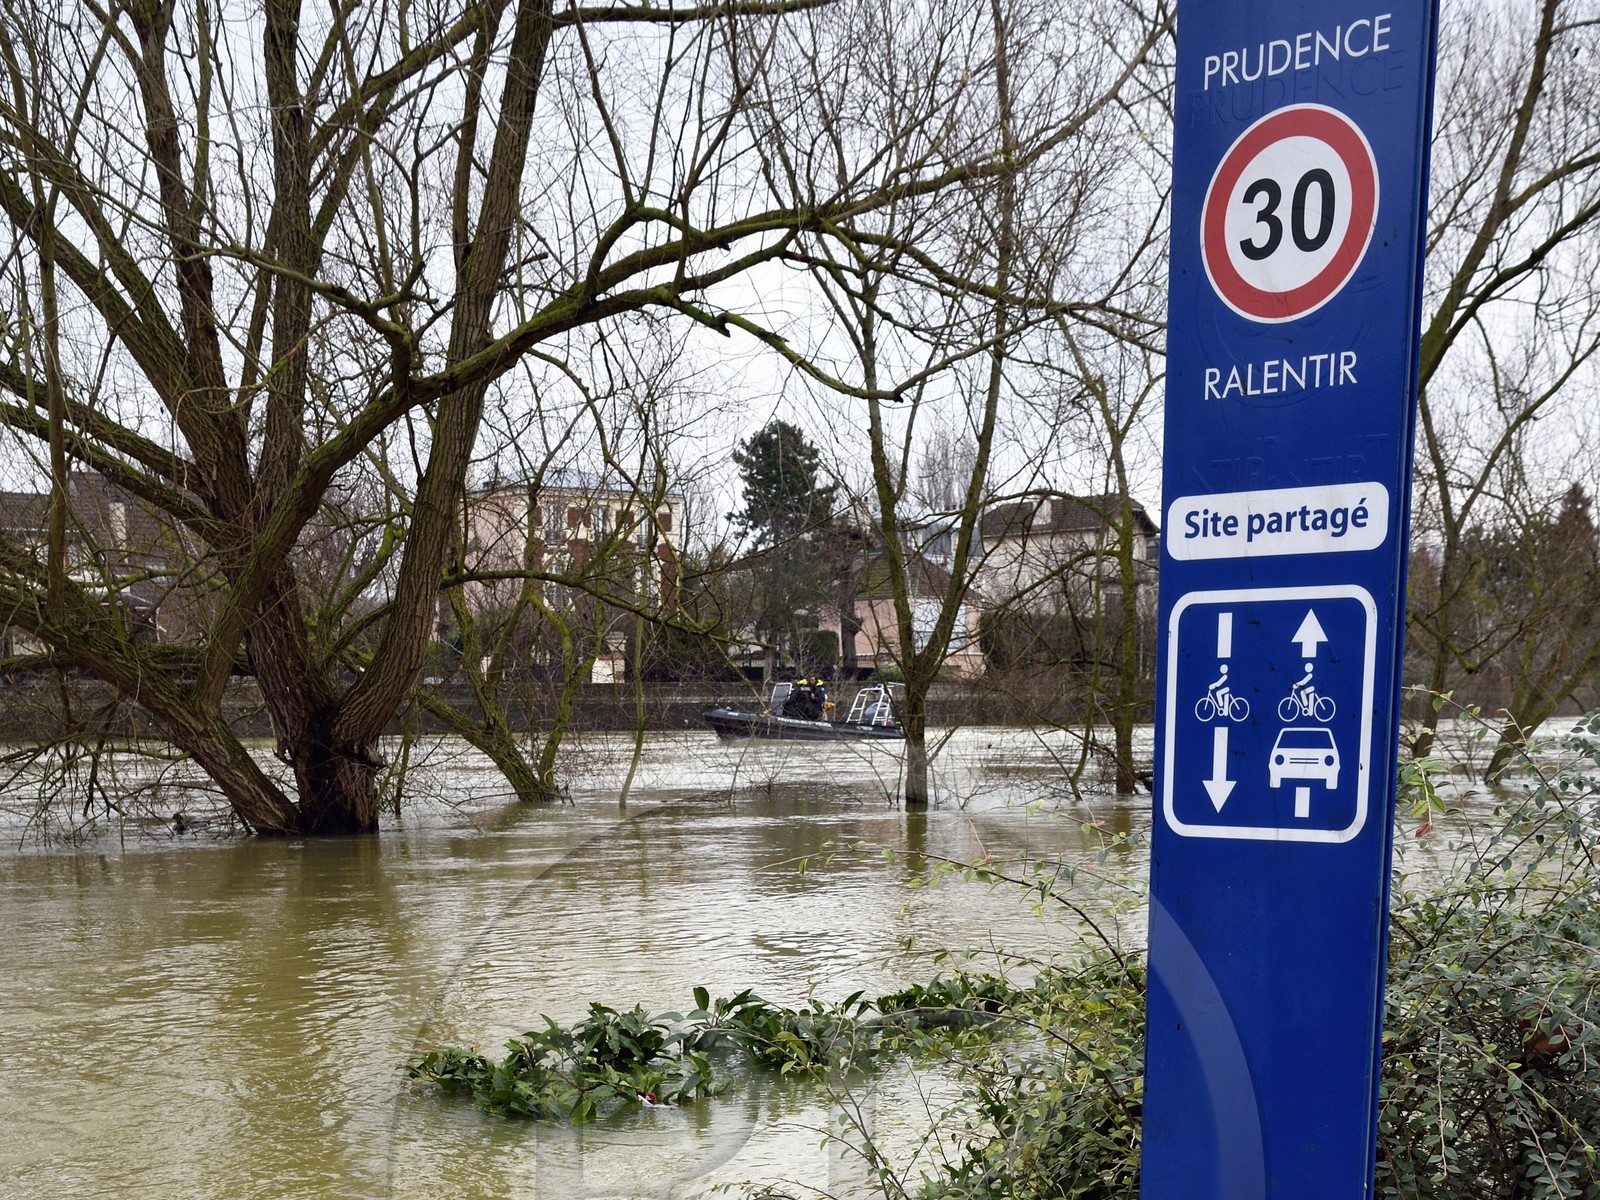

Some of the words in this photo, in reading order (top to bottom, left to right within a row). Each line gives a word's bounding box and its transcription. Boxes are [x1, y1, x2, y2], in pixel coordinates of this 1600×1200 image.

[1203, 13, 1392, 91] PRUDENCE
[1239, 167, 1336, 261] 30
[1204, 350, 1358, 401] RALENTIR
[1184, 510, 1238, 540] Site
[1246, 497, 1369, 543] partagé
